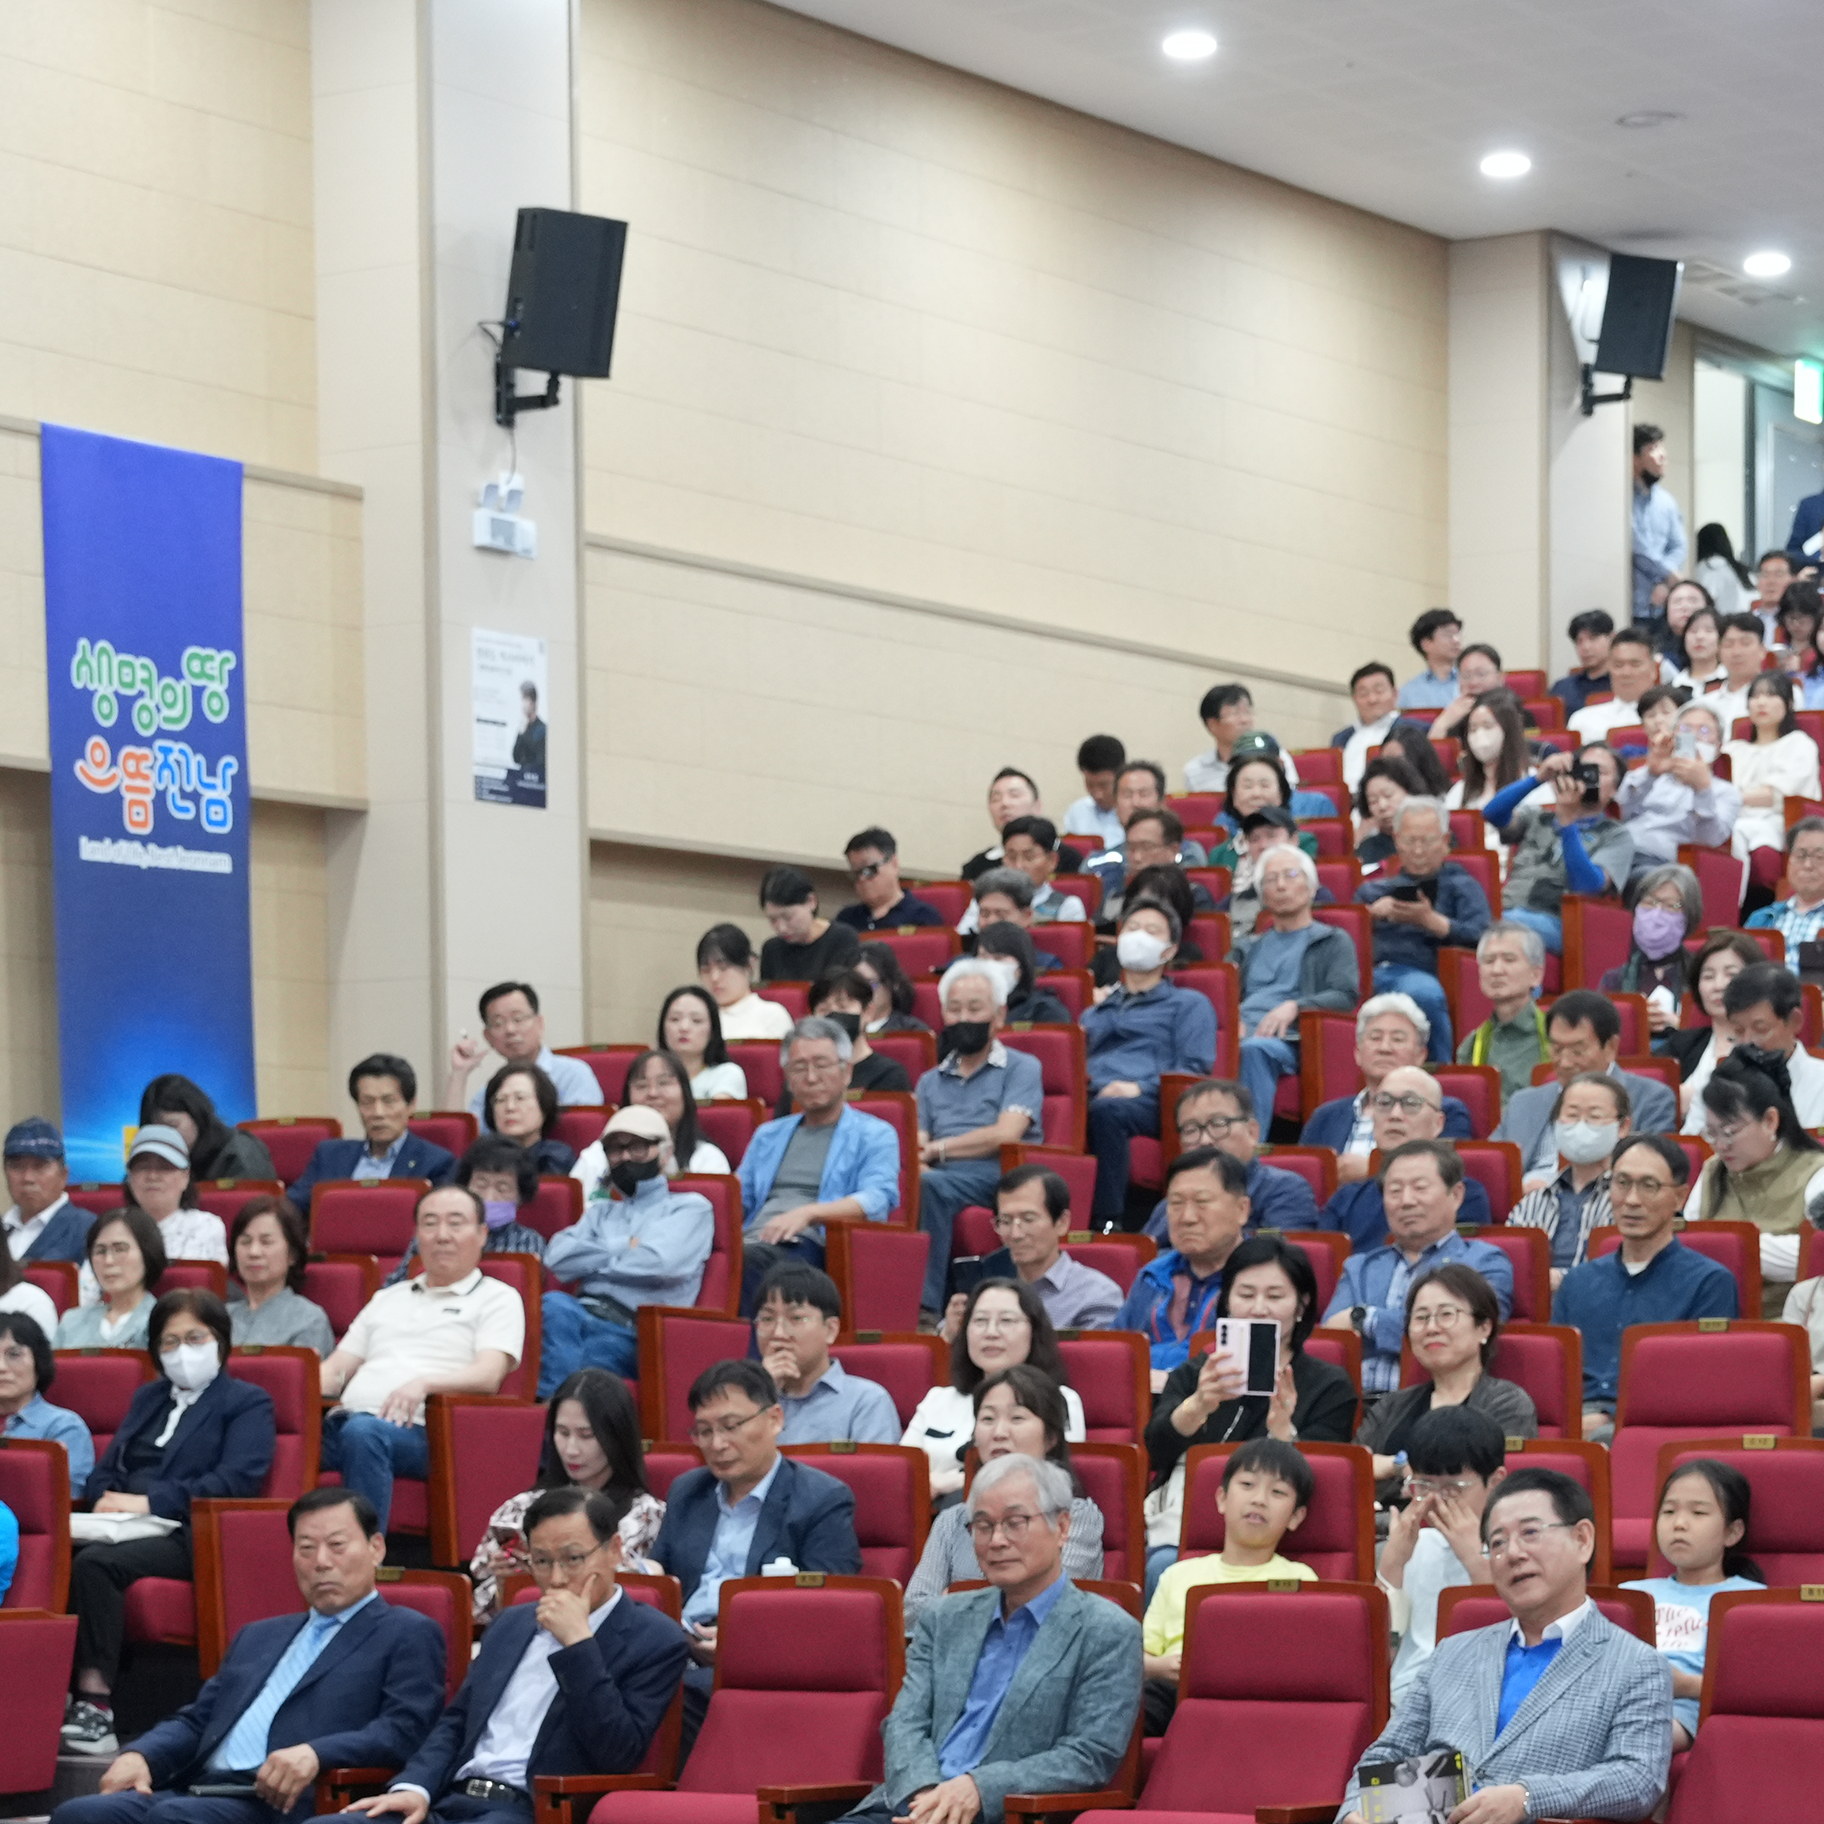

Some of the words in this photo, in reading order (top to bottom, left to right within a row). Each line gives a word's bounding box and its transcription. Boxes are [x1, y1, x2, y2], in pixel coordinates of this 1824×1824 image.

[72, 639, 191, 735] 생명의
[182, 647, 235, 722] 땅
[75, 736, 154, 834] 으뜸
[153, 740, 238, 832] 전남
